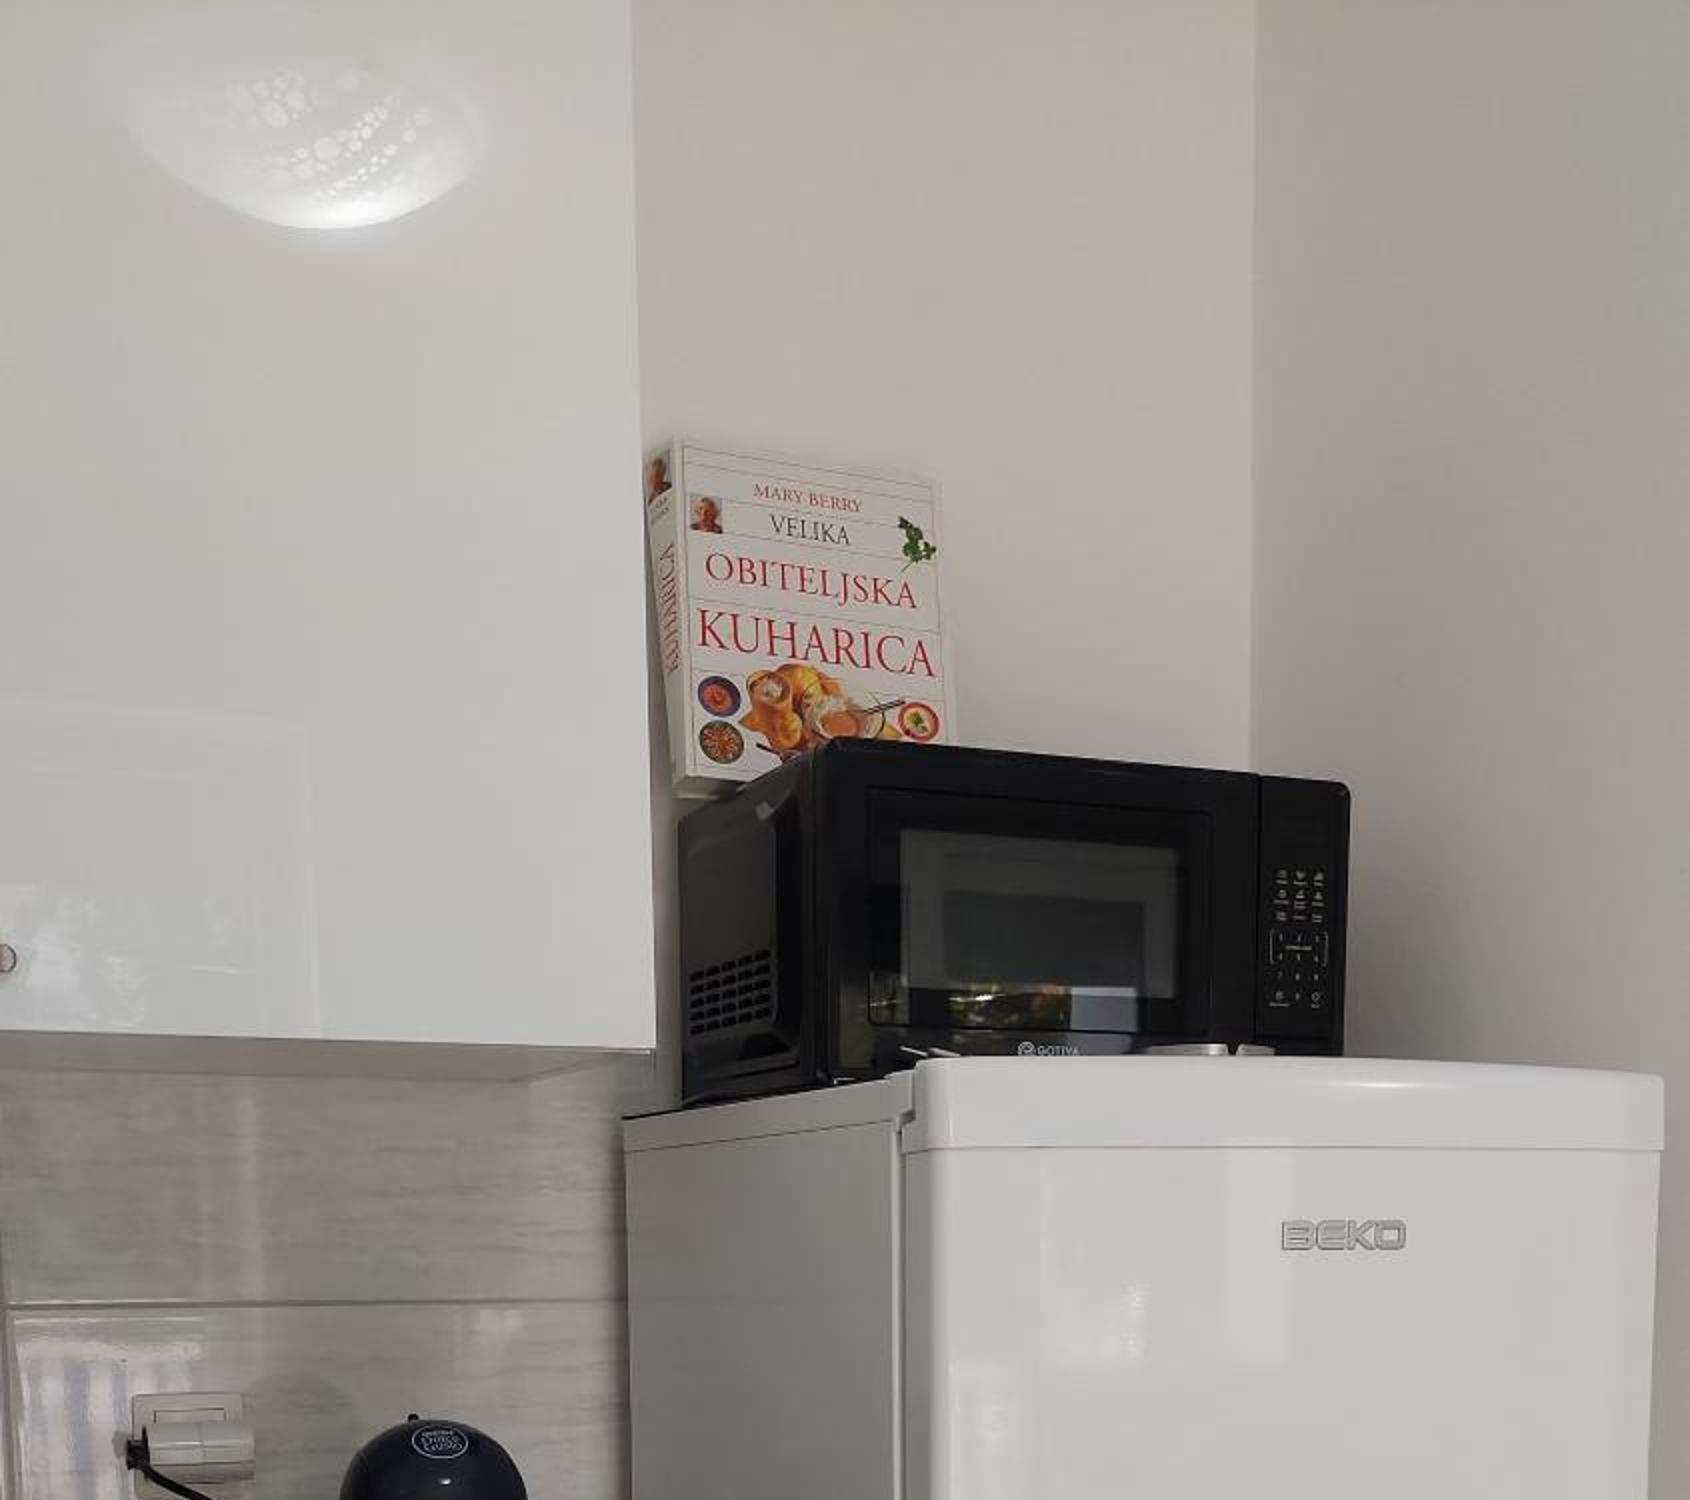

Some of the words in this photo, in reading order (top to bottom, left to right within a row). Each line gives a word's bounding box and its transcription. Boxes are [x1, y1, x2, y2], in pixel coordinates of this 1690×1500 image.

[753, 483, 803, 504] MARY
[808, 492, 863, 513] BERRY
[769, 514, 850, 545] VELIKA
[705, 553, 917, 608] OBITELJSKA
[696, 607, 936, 678] KUHARICA
[1281, 1219, 1407, 1251] BEKO
